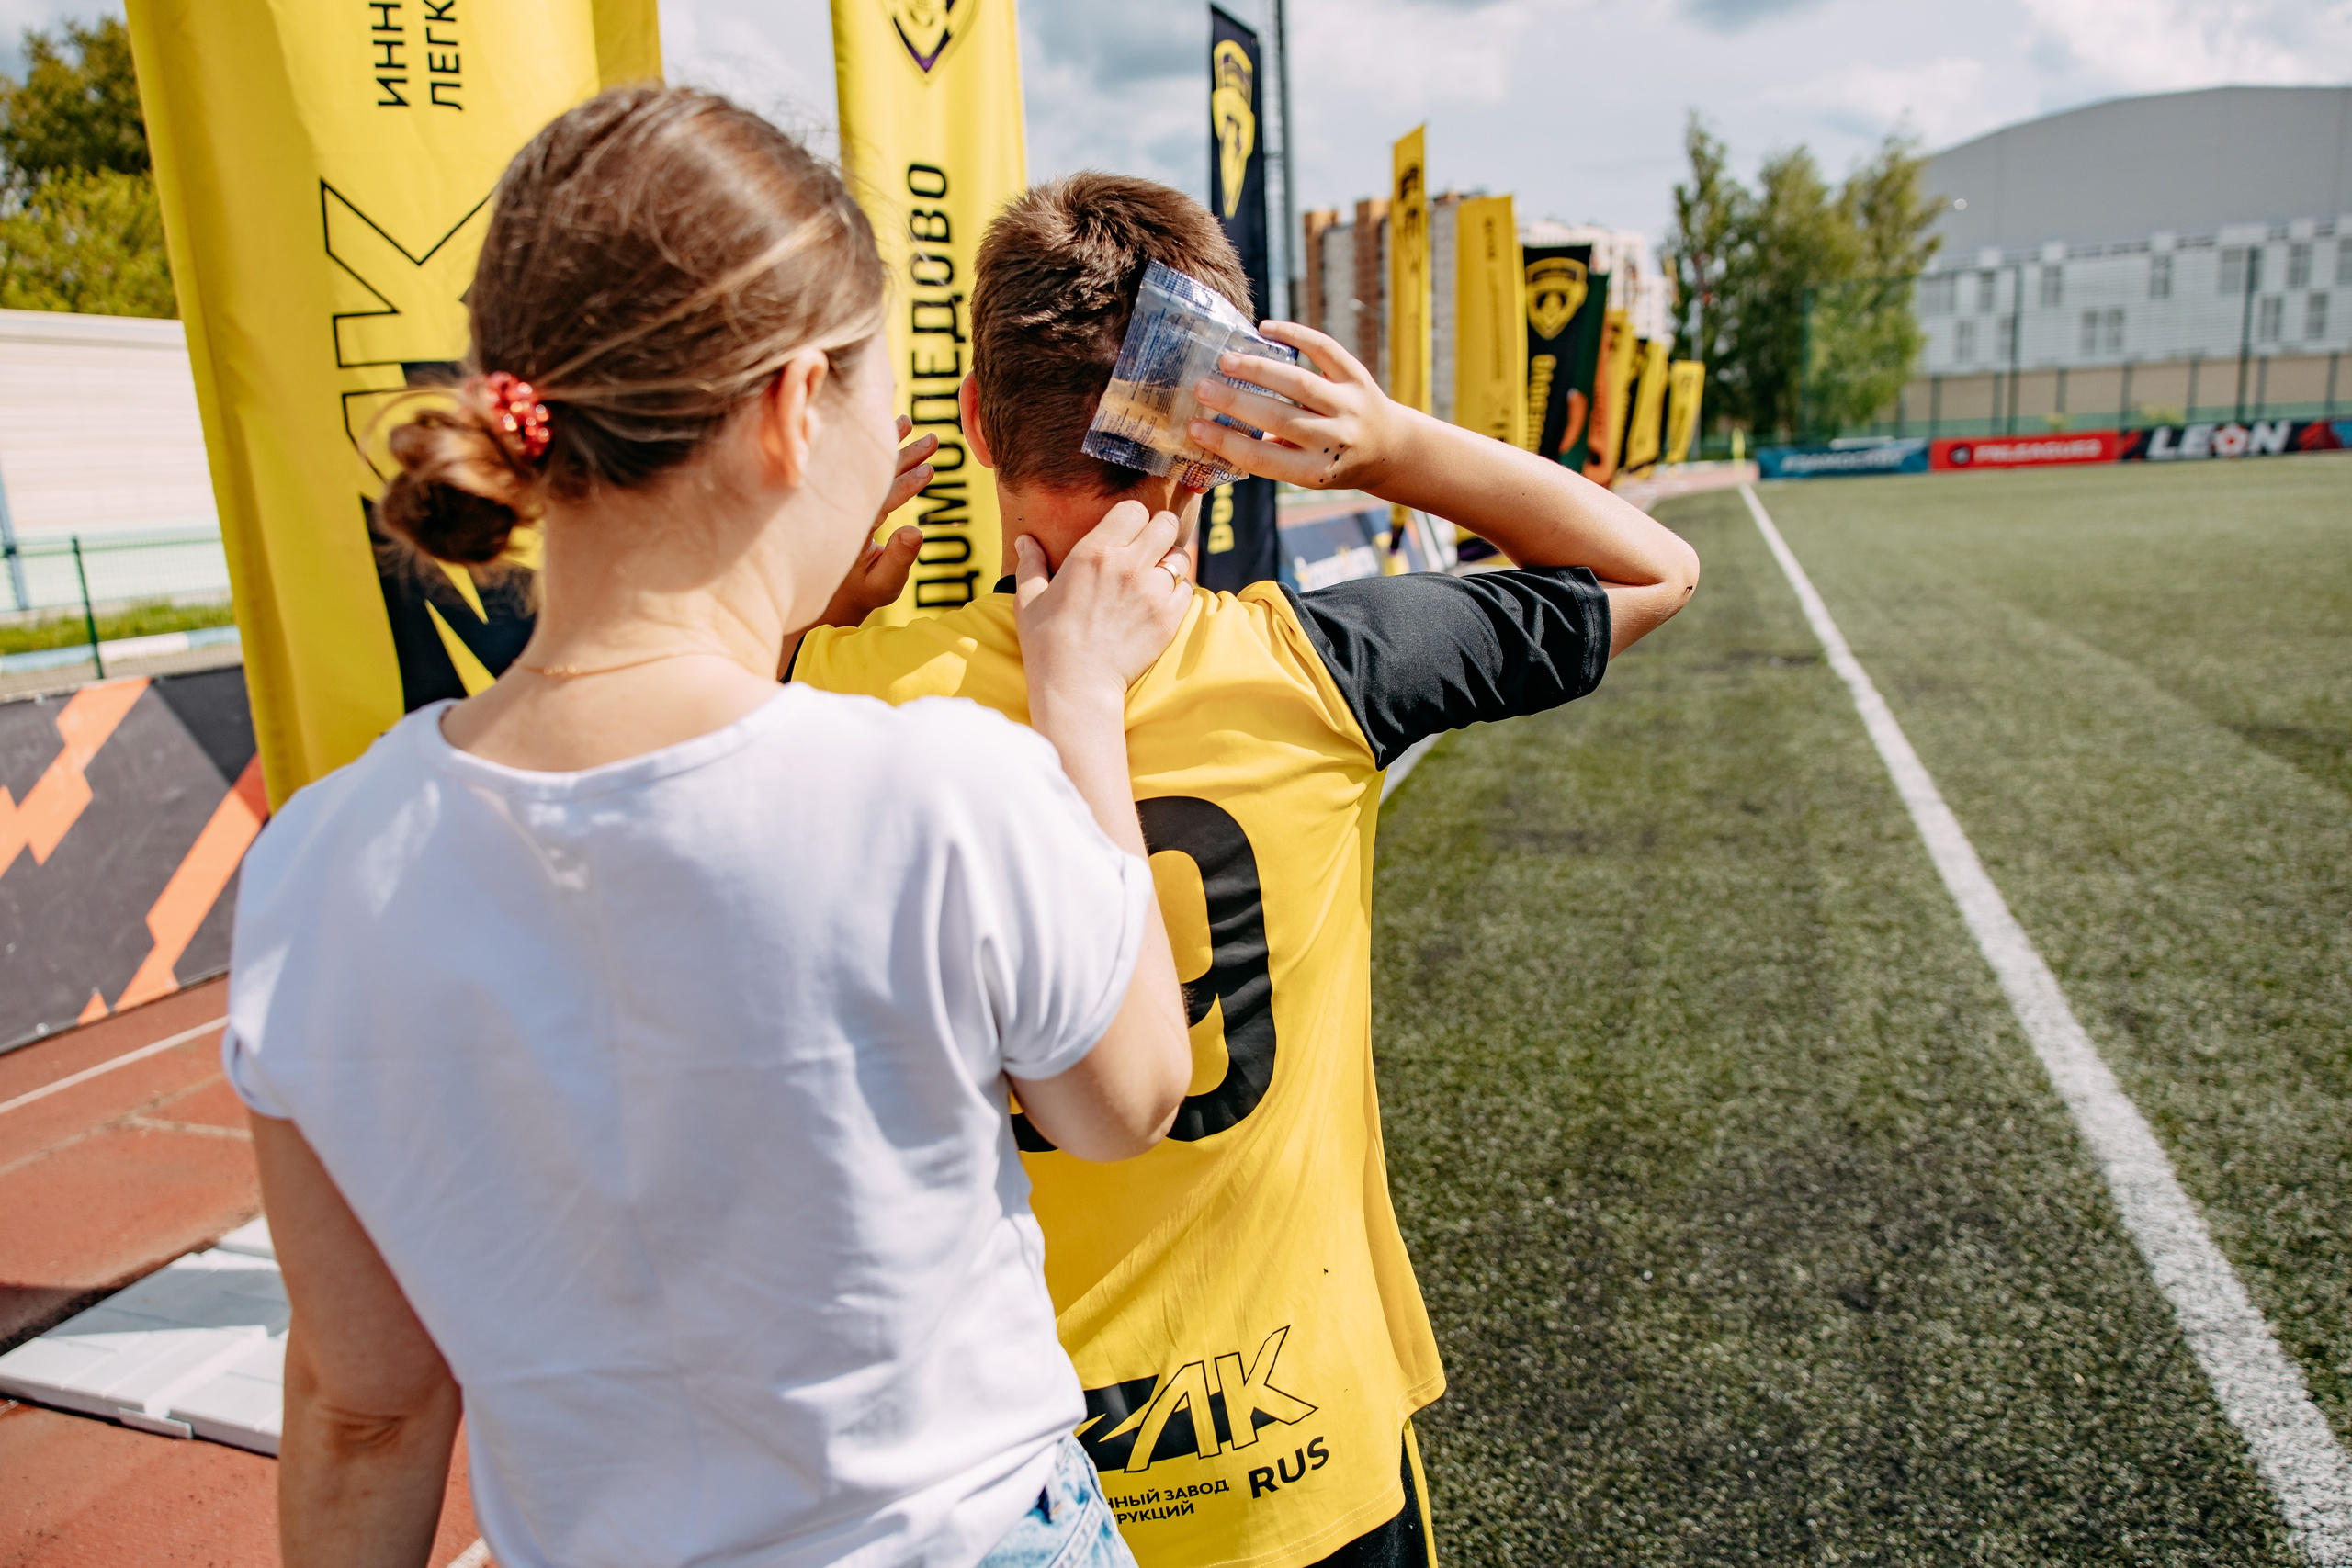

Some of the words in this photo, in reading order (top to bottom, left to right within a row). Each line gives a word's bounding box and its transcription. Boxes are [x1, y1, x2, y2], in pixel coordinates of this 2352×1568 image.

[369, 2, 410, 107] ИНН
[423, 0, 463, 111] ЛЕГК
[907, 163, 980, 609] ДОМОДЕДОВО
[2145, 420, 2291, 461] LEON
[1163, 1479, 1230, 1502] ЗАВОД
[1248, 1436, 1329, 1500] RUS
[1114, 1500, 1195, 1525] РУКЦИЙ
